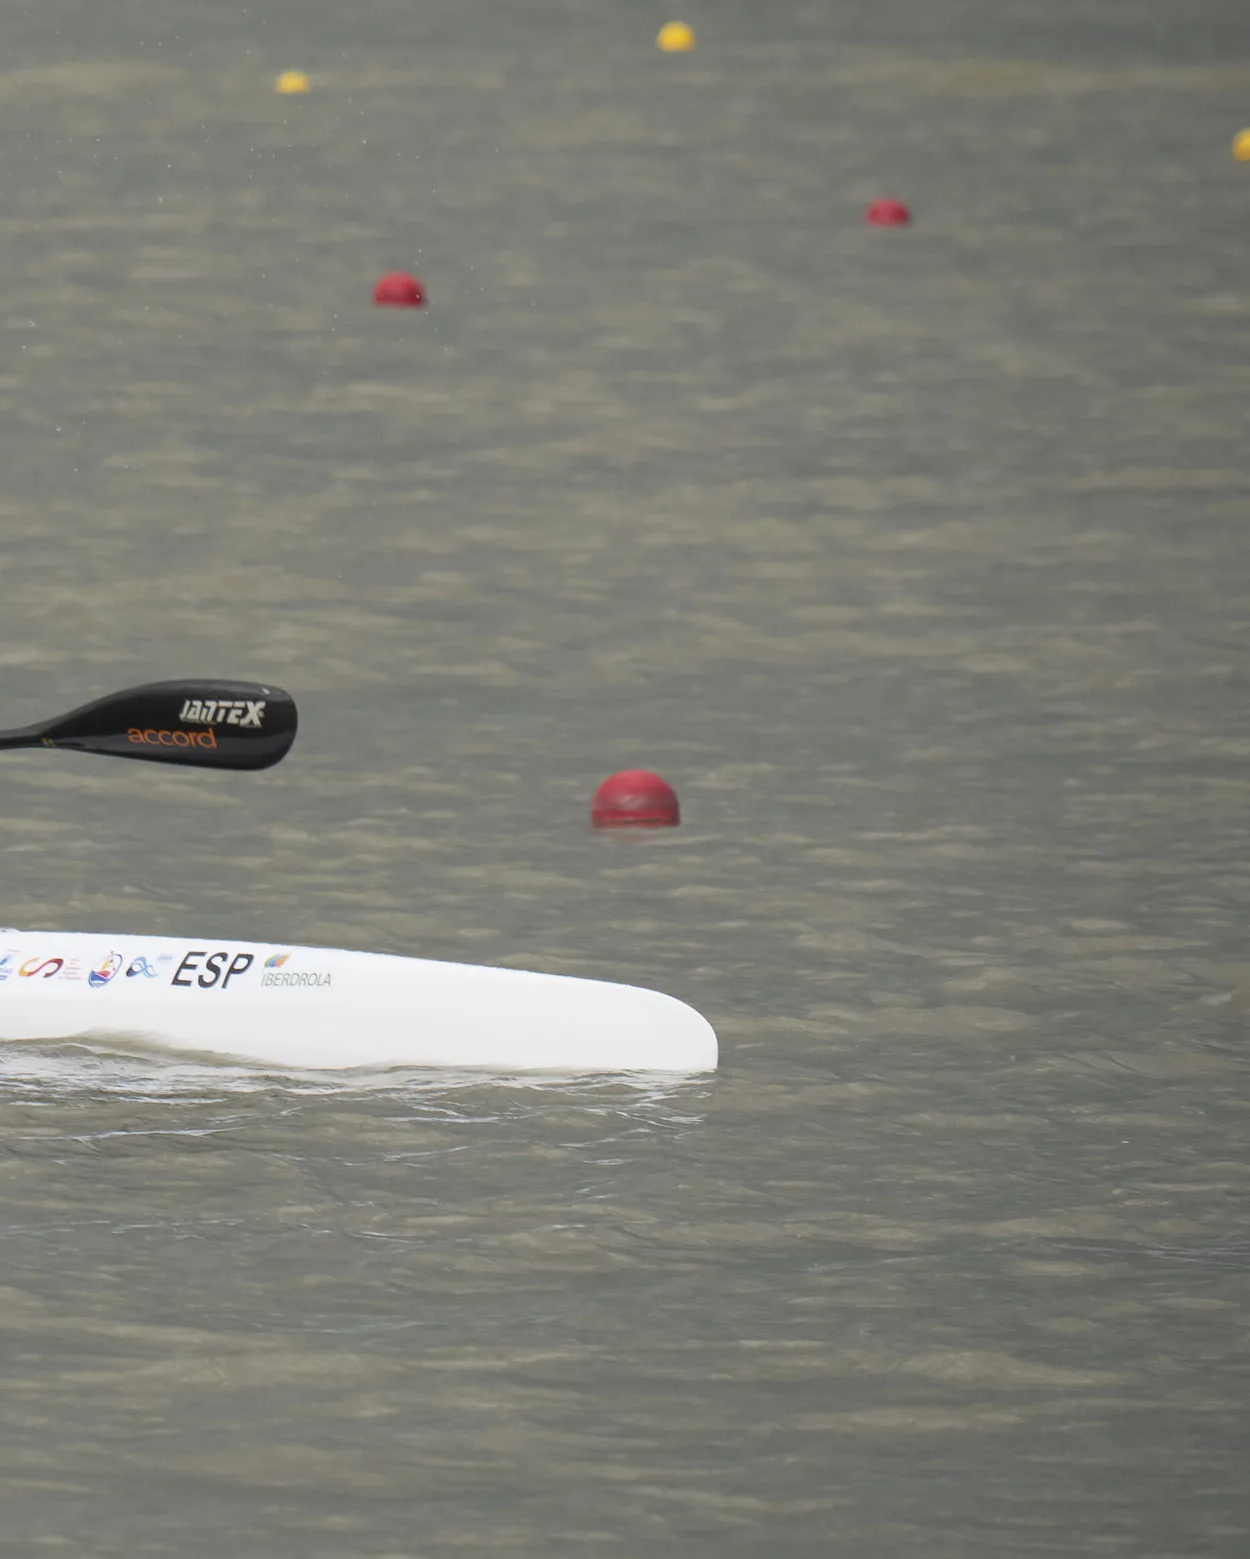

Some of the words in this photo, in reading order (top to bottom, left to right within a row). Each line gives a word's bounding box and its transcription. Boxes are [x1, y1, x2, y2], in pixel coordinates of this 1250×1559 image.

[127, 727, 218, 749] accord
[171, 951, 254, 989] ESP
[261, 972, 331, 988] IBERDROLA
